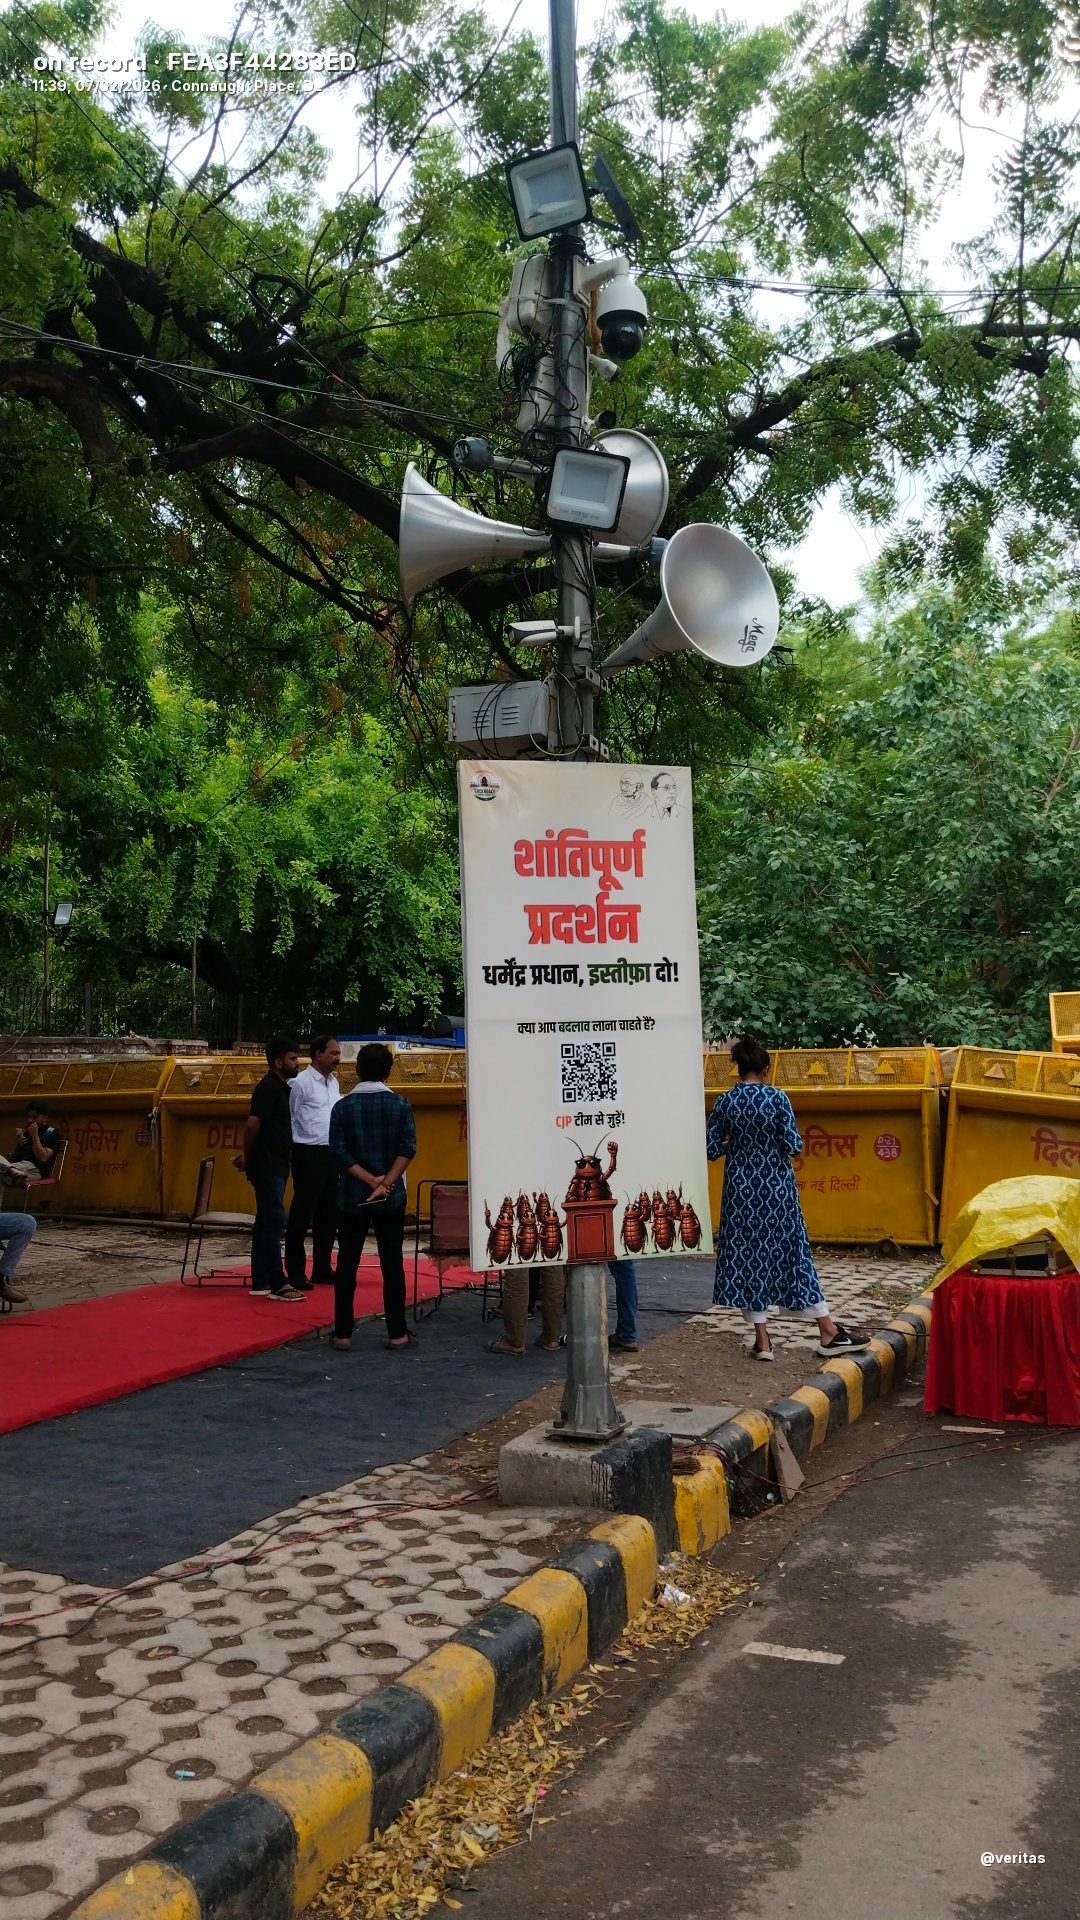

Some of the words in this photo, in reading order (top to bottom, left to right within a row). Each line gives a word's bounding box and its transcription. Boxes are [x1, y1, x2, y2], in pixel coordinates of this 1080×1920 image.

[738, 617, 765, 652] Mega
[514, 828, 646, 891] शांतिपूर्ण
[524, 892, 641, 944] प्रदर्शन
[482, 957, 527, 987] धर्मेंद्र
[529, 964, 584, 987] प्रधान,
[587, 957, 652, 986] इस्तीफ़ा
[654, 956, 679, 983] दो!
[517, 1022, 536, 1034] क्या
[538, 1022, 557, 1033] आप
[558, 1021, 590, 1032] बदलाव
[592, 1020, 617, 1031] लाना
[618, 1016, 642, 1031] चाहते
[643, 1016, 656, 1031] हैं?
[556, 1115, 572, 1129] CJP
[574, 1111, 593, 1126] टीम
[594, 1110, 605, 1125] से
[606, 1109, 625, 1128] जुड़ें!
[72, 1120, 124, 1160] पुलिस
[877, 1147, 898, 1158] 438
[830, 1174, 861, 1192] दिल्ली
